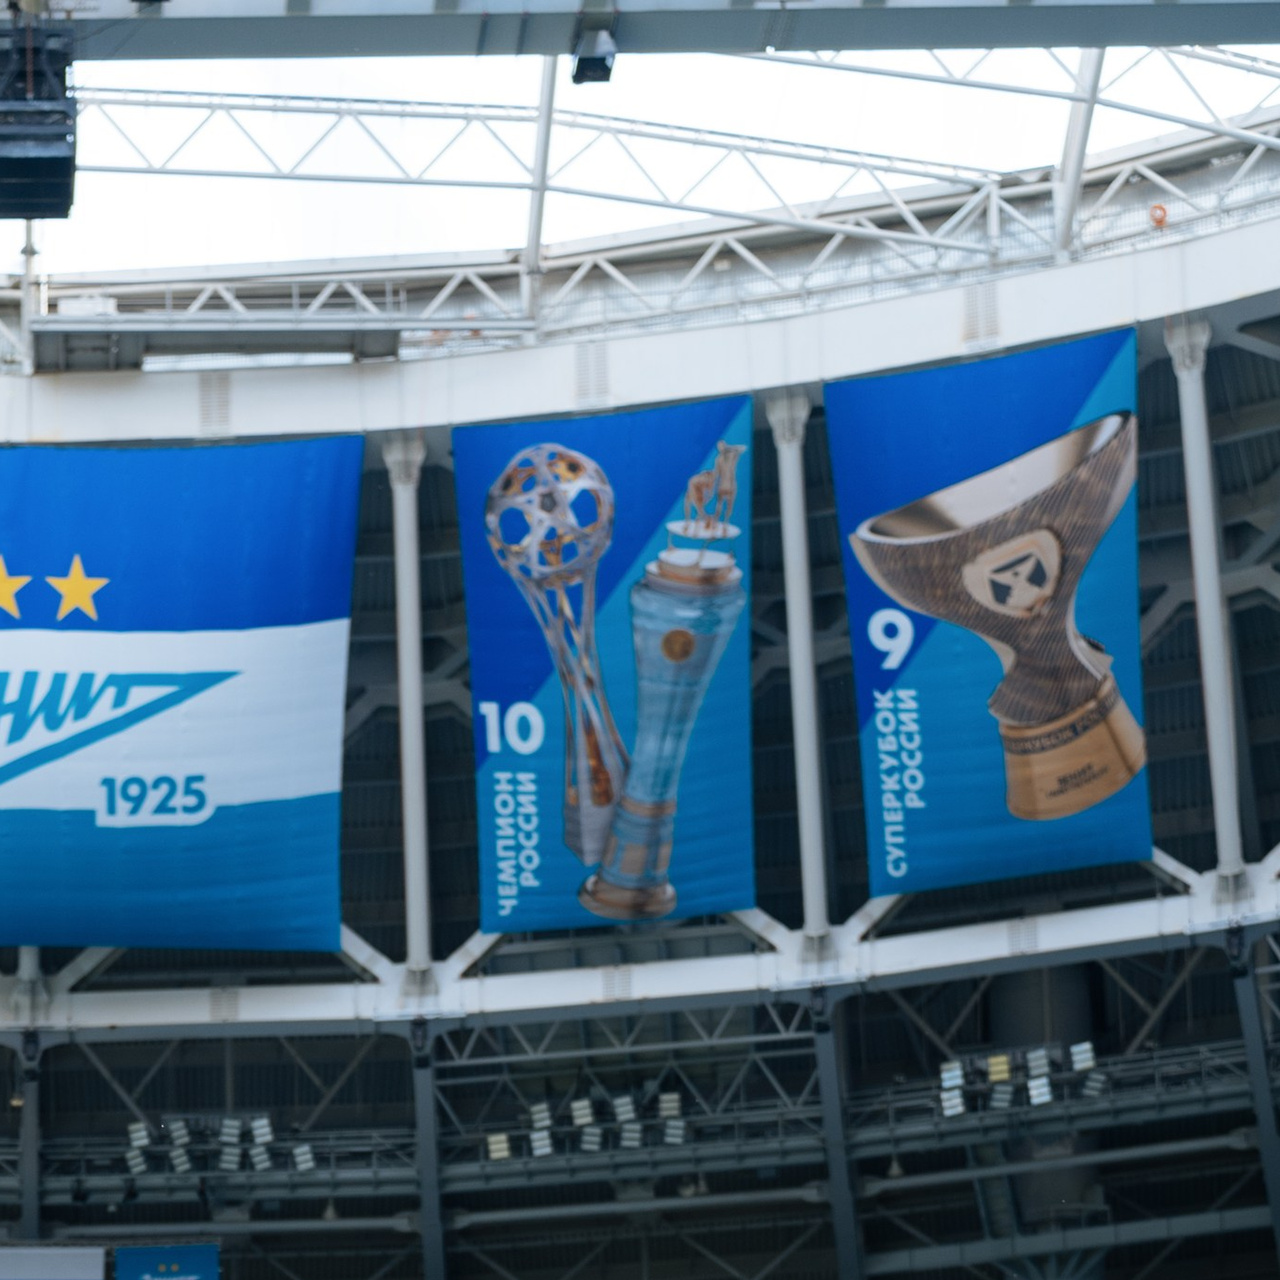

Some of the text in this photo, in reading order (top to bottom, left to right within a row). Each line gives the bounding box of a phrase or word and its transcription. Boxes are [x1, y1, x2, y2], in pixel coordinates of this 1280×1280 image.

[867, 608, 915, 671] 9
[479, 701, 545, 755] 10
[873, 688, 908, 878] СУПЕРКУБОК
[896, 688, 927, 809] РОССИИ
[100, 774, 206, 816] 1925
[493, 771, 518, 917] ЧЕМПИОН
[516, 772, 541, 888] РОССИИ
